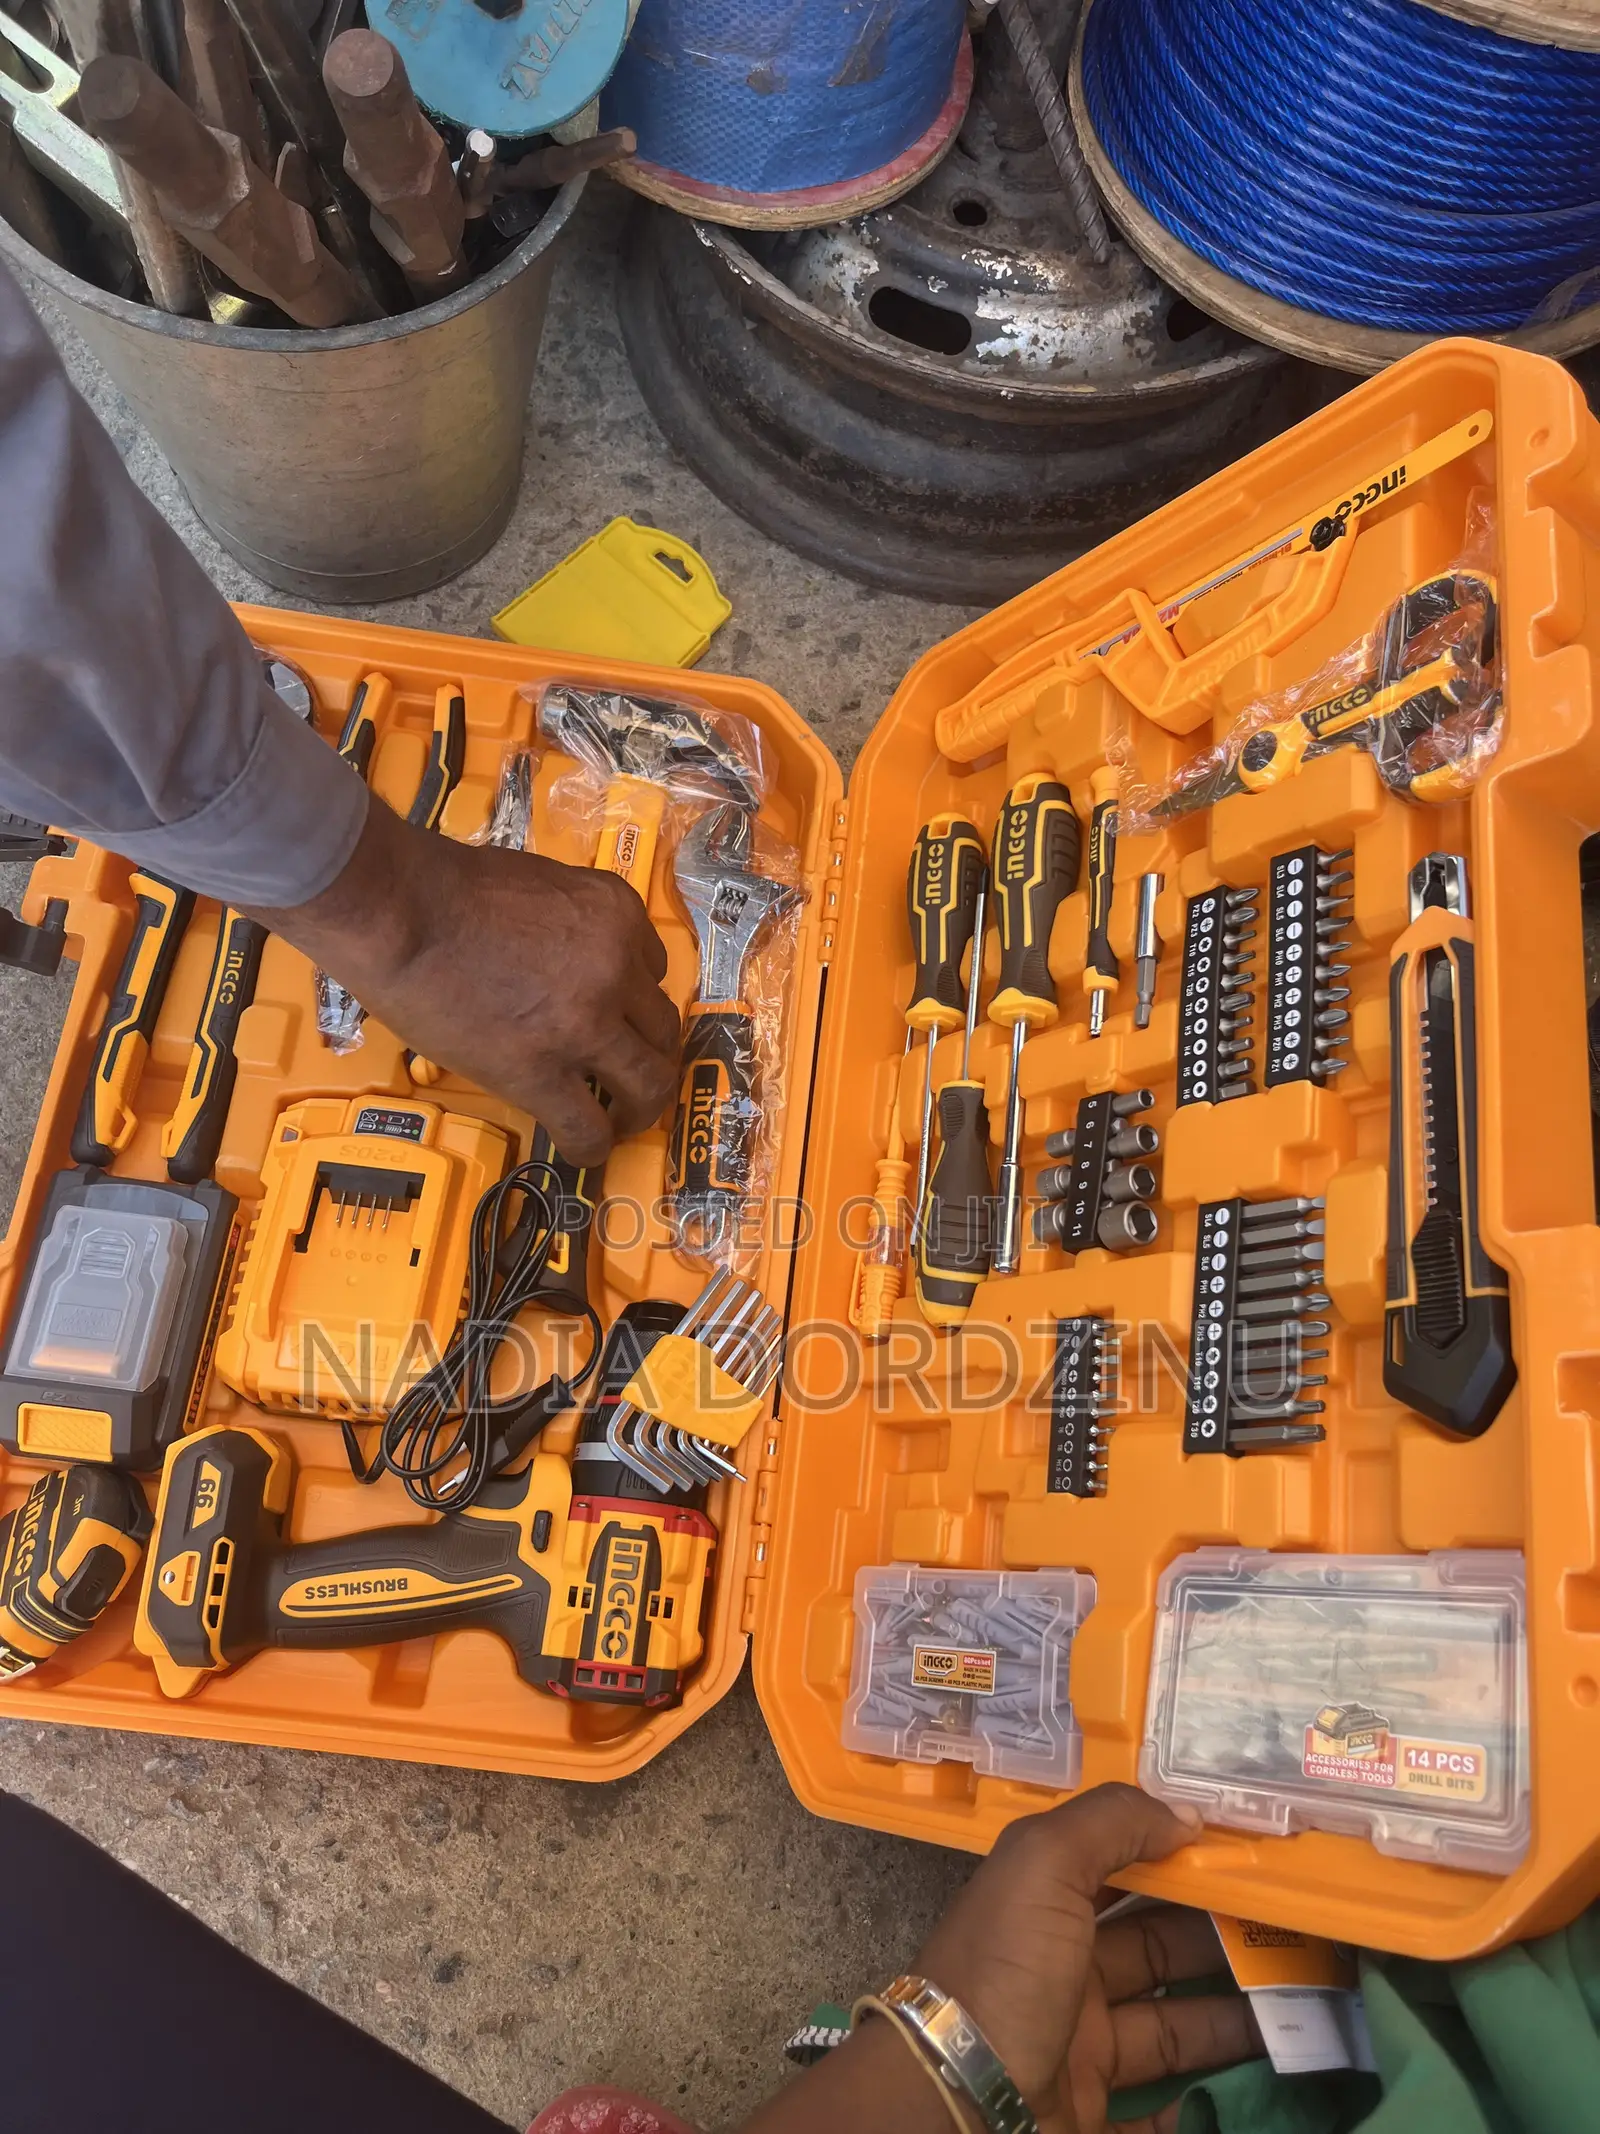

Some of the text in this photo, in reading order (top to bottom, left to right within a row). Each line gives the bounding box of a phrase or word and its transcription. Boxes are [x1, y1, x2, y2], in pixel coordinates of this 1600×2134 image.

[1276, 864, 1286, 879] SL3
[1276, 884, 1285, 899] SL4
[1192, 903, 1201, 919] PZ2
[1275, 906, 1285, 921] SL5
[1190, 922, 1199, 938] PZ3
[1275, 927, 1284, 942] SL6
[1188, 942, 1197, 957] T10
[1275, 950, 1284, 966] PH0
[1274, 972, 1284, 987] PH1
[1186, 982, 1194, 997] T20
[1273, 993, 1283, 1009] PH2
[1185, 1002, 1193, 1017] T30
[1184, 1024, 1192, 1036] H3
[1273, 1014, 1282, 1031] PH3
[1183, 1045, 1191, 1057] H4
[1272, 1037, 1281, 1052] PZ0
[1182, 1066, 1191, 1077] H5
[1271, 1058, 1280, 1073] PZ1
[1182, 1088, 1190, 1100] H6
[1087, 1100, 1097, 1109] 5
[1085, 1120, 1095, 1129] 6
[1083, 1140, 1093, 1149] 7
[1080, 1160, 1090, 1169] 8
[1078, 1181, 1088, 1190] 9
[1075, 1200, 1085, 1215] 10
[1204, 1213, 1213, 1227] SL4
[1072, 1223, 1082, 1237] 11
[1202, 1234, 1211, 1249] SL5
[1201, 1256, 1210, 1271] SL6
[1199, 1279, 1208, 1294] PH1
[1198, 1303, 1207, 1319] PH2
[1196, 1325, 1205, 1342] PH3
[1191, 1398, 1200, 1415] T20
[1190, 1420, 1199, 1438] T30
[305, 1577, 408, 1600] BRUSHLESS
[1305, 1753, 1394, 1773] ACCESSORIES FOR
[1407, 1749, 1475, 1774] 14 PCS
[1309, 1764, 1394, 1785] CORDLESS TOOLS
[1408, 1771, 1475, 1791] DRILL BITS
